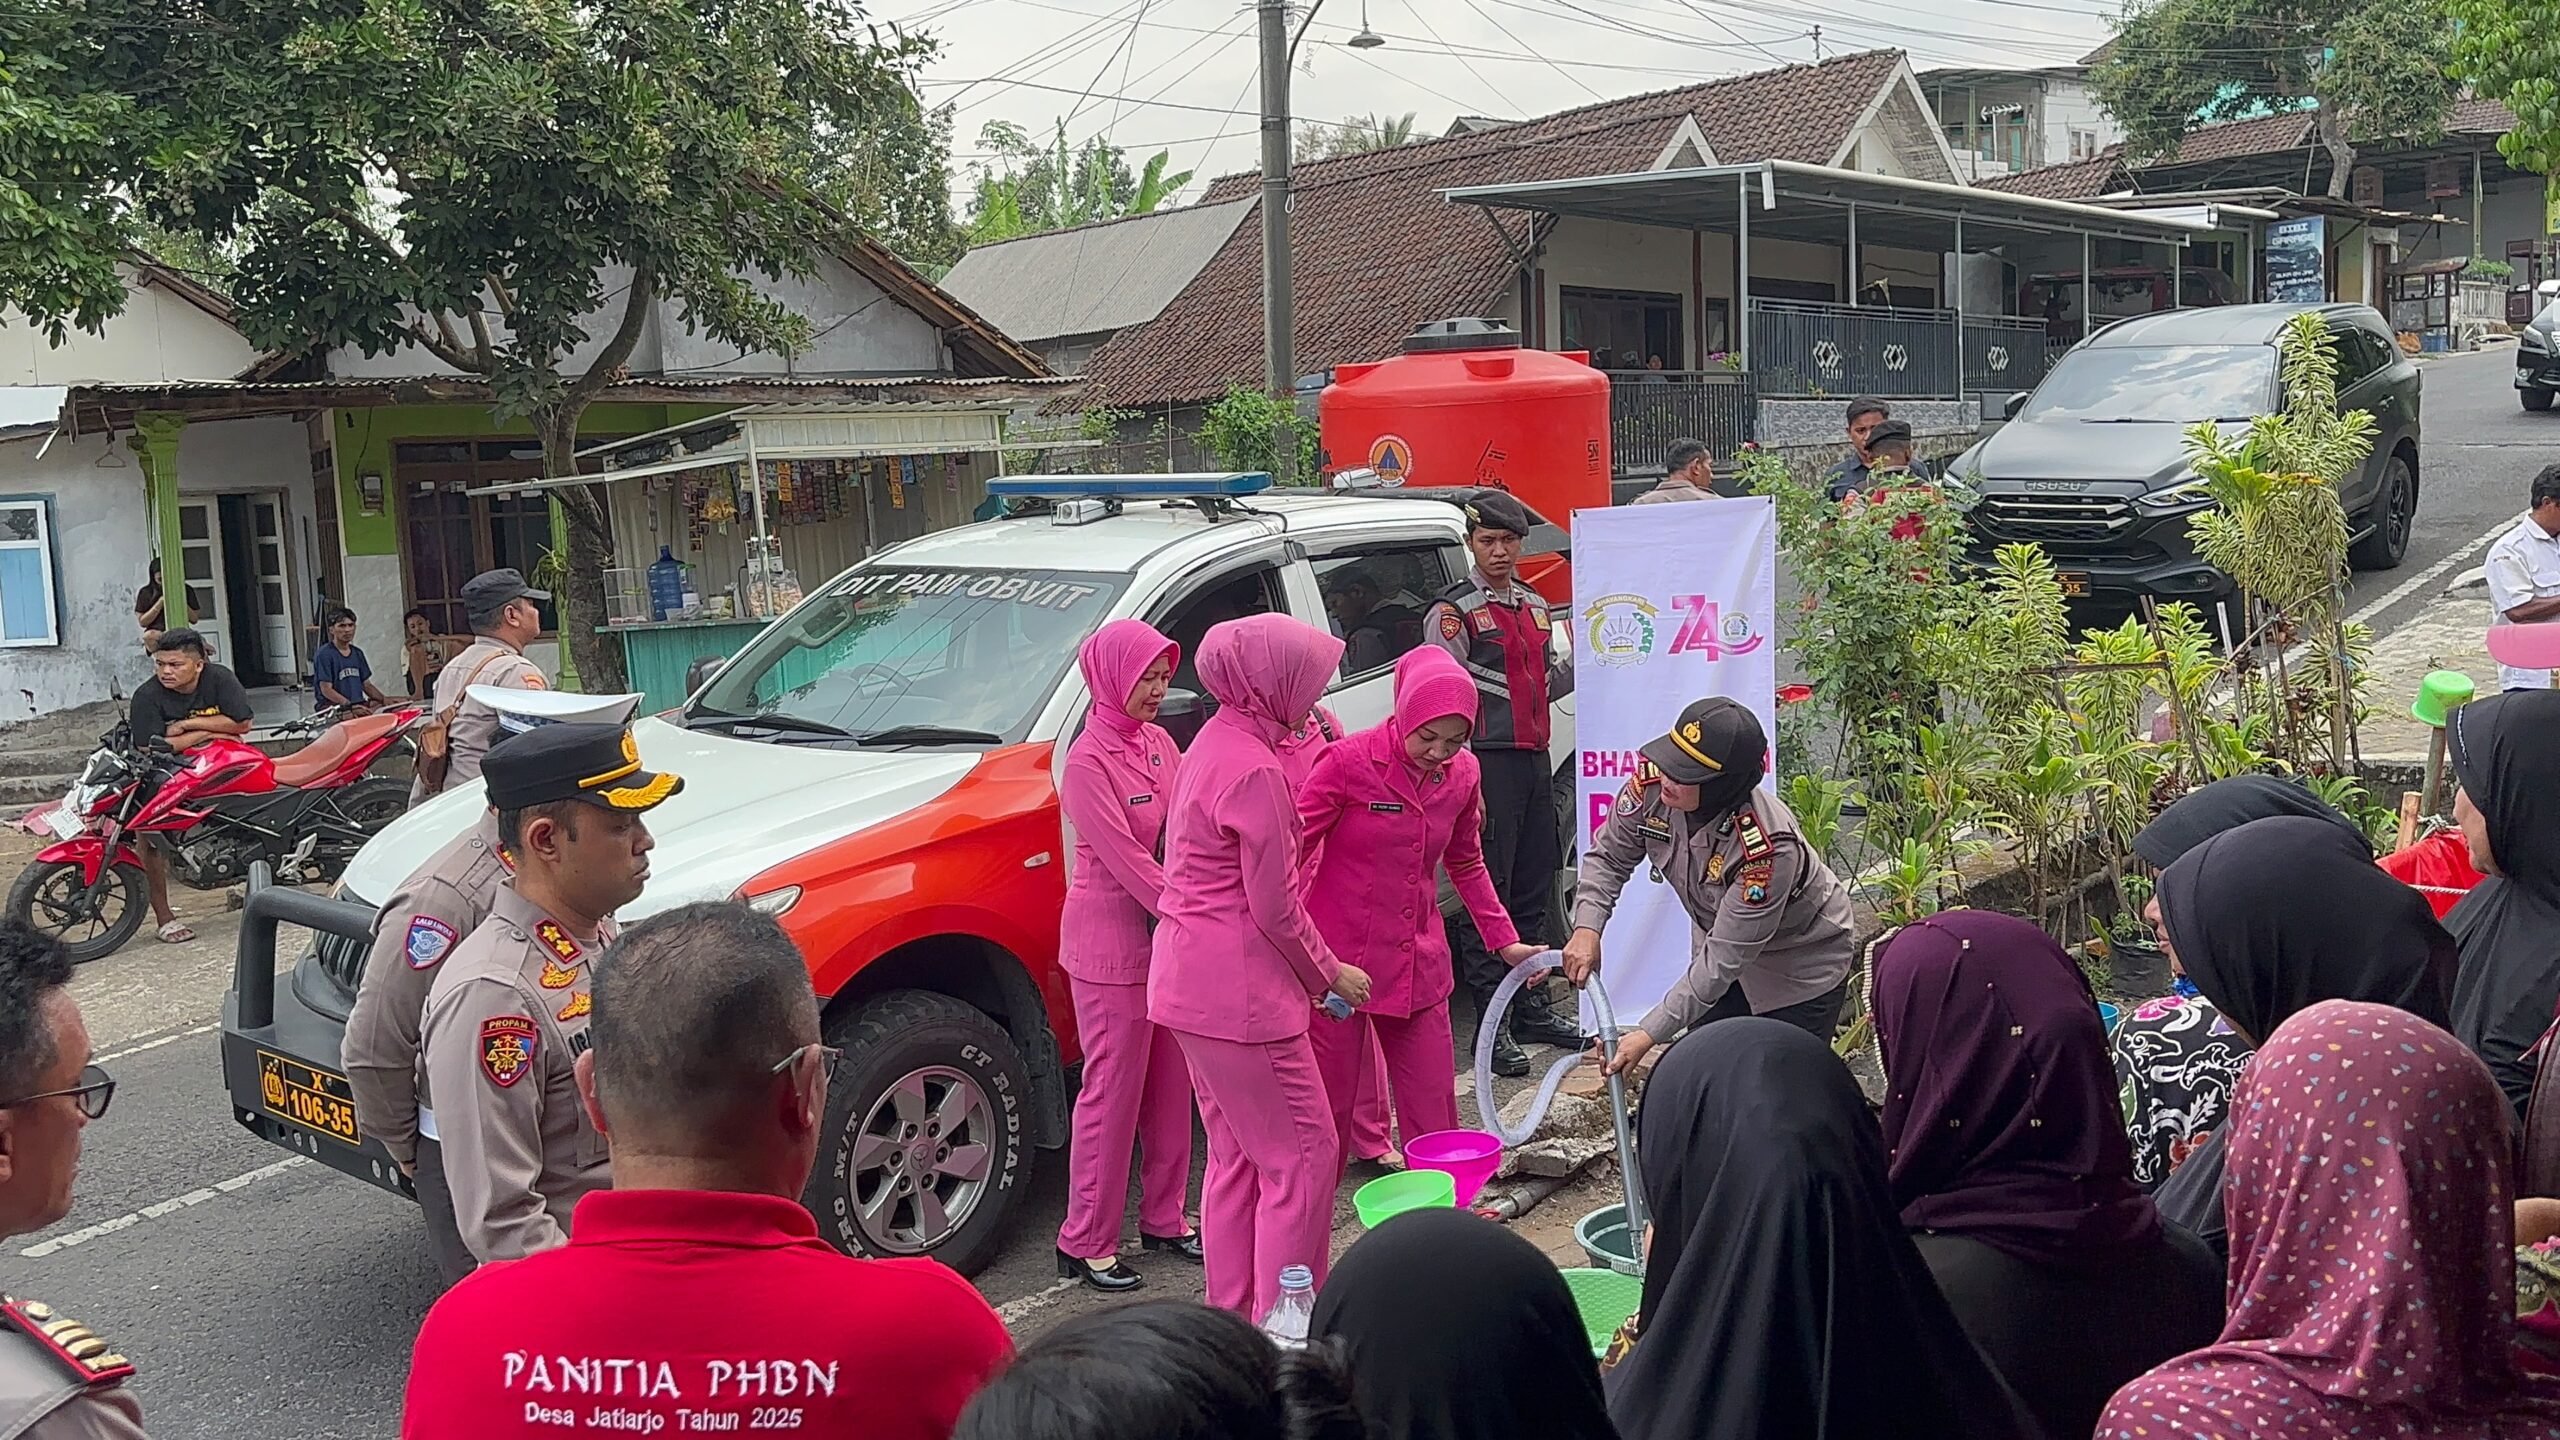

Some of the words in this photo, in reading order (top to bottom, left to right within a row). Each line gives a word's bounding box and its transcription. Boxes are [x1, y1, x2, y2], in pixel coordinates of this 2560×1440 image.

[2272, 233, 2316, 246] GARAGE
[2032, 482, 2081, 491] ISUZU
[829, 574, 896, 597] DIT
[886, 573, 970, 596] PAM
[966, 576, 1095, 609] OBVIT
[1668, 594, 1720, 662] 74
[415, 917, 434, 926] LALU
[433, 920, 453, 937] LINTAS
[489, 1019, 528, 1030] PROPAM
[311, 1071, 325, 1092] X
[291, 1089, 354, 1135] 106-35
[960, 1044, 993, 1067] GT
[992, 1072, 1021, 1191] RADIAL
[833, 1111, 859, 1179] M/T
[502, 1350, 681, 1399] PANITIA
[706, 1358, 839, 1397] PHBN
[525, 1402, 575, 1427] Desa
[586, 1406, 664, 1435] Jatiarjo
[675, 1408, 739, 1431] Tahun
[750, 1407, 803, 1429] 2025
